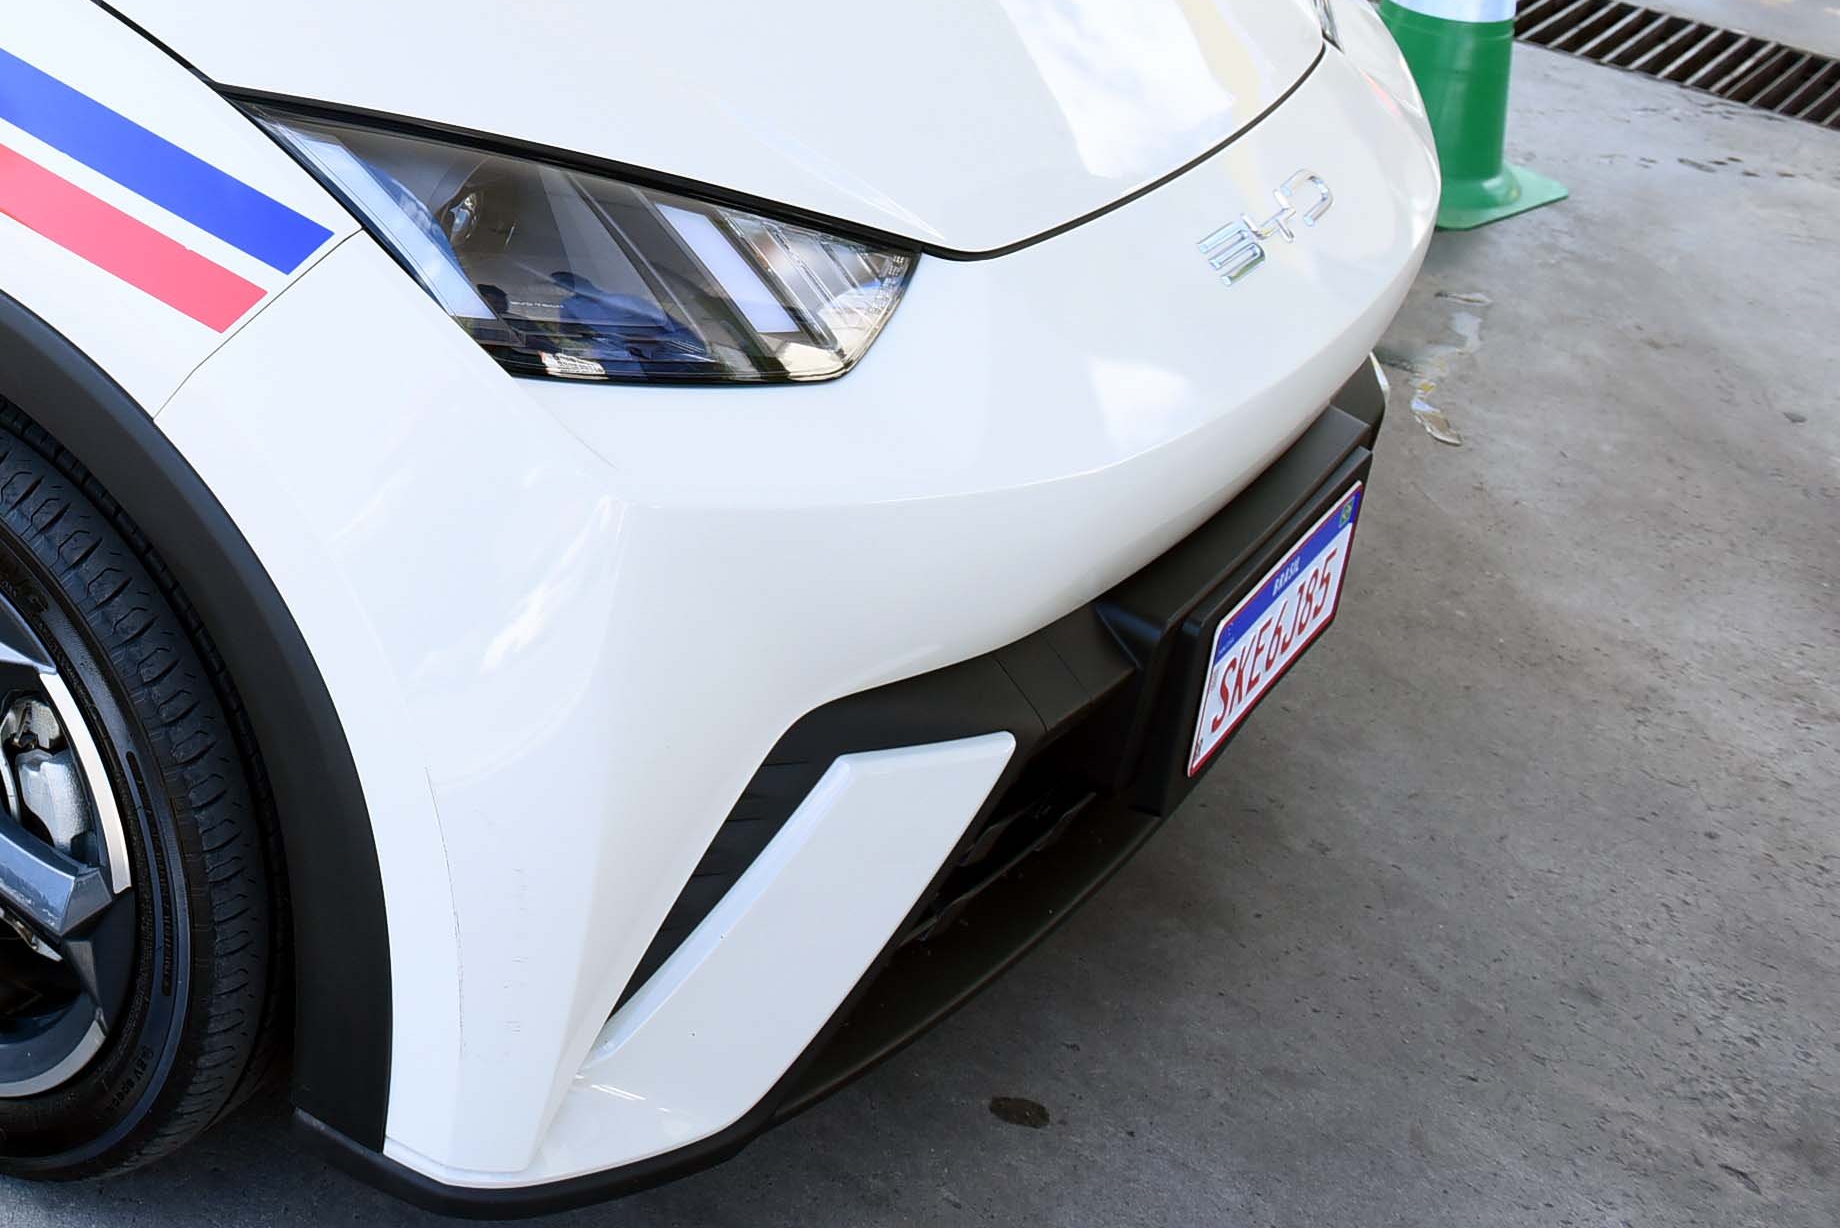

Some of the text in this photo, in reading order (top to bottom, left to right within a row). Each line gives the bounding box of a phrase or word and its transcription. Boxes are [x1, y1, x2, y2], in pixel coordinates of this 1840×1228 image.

[1196, 167, 1335, 287] BYD
[1271, 555, 1301, 597] BRASIL
[1210, 547, 1338, 734] SKE6J85
